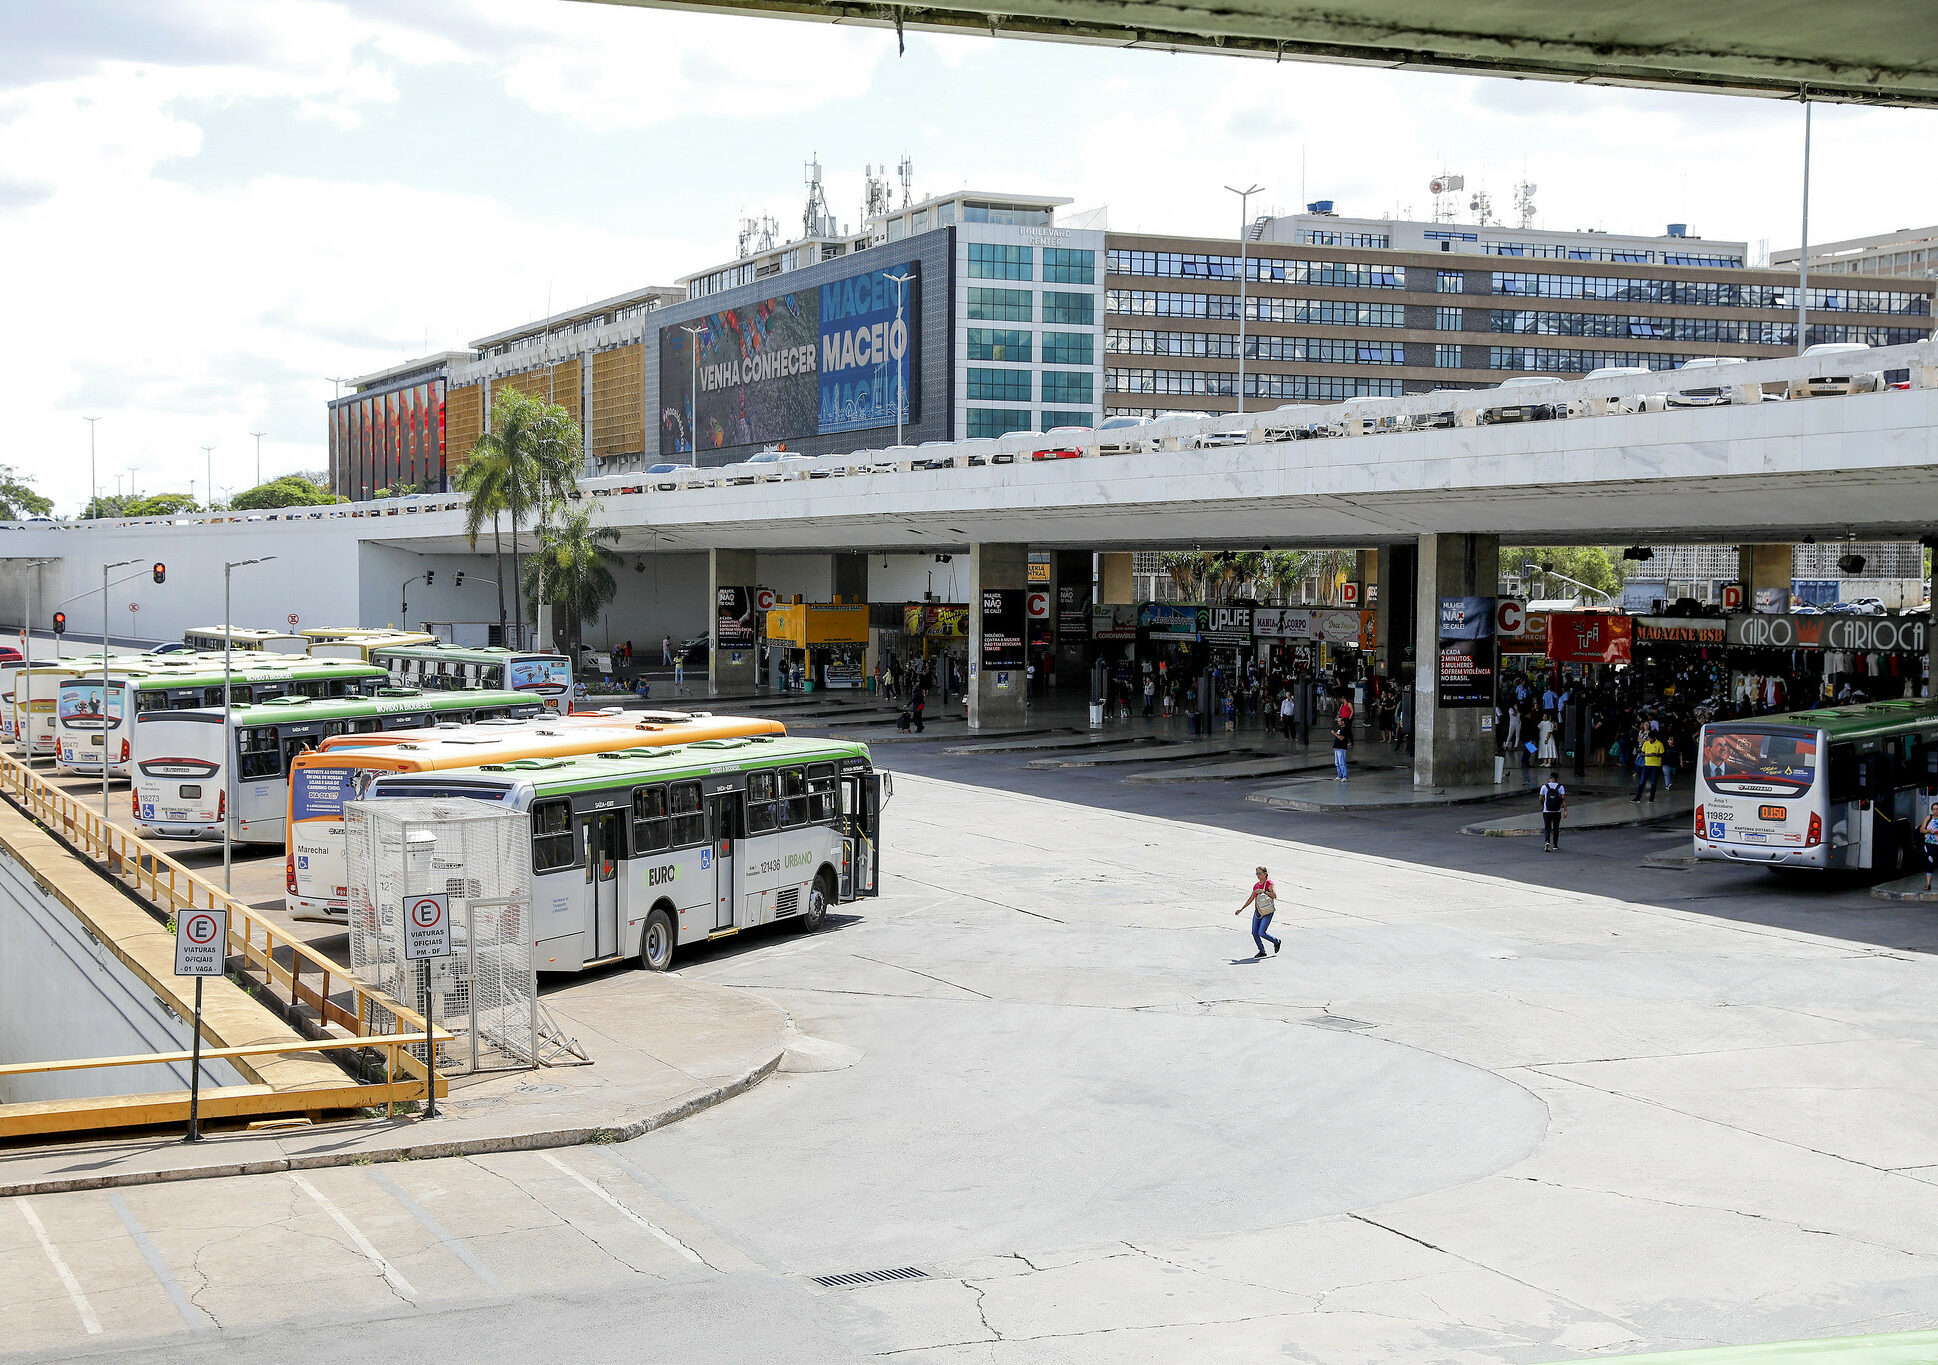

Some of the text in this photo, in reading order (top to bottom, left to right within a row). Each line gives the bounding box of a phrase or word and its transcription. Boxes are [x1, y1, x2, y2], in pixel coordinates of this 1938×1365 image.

[1019, 227, 1071, 238] BOULEVARD
[699, 344, 817, 392] VENHA CONHECER
[1344, 584, 1356, 600] D
[1725, 587, 1740, 607] D
[758, 591, 773, 609] C
[983, 597, 1002, 609] NÃO
[1027, 594, 1046, 616] C
[1208, 608, 1250, 631] UPLIFE
[1442, 608, 1465, 621] NÃO
[1498, 602, 1521, 632] C
[1256, 618, 1307, 629] MANIA CORPO
[1636, 626, 1724, 642] MAGAZINE BSB
[1828, 619, 1924, 650] CARIOCA
[1463, 667, 1491, 675] VIOLÊNCIA
[375, 702, 399, 713] MOVIDO
[404, 700, 433, 711] BIODIESEL
[1706, 811, 1734, 821] 119822
[1761, 807, 1786, 819] 0.150
[297, 845, 329, 855] Marechal
[760, 850, 813, 873] 121436 URBANO
[419, 904, 433, 922] E
[195, 920, 208, 938] E
[410, 929, 445, 938] VIATURAS
[183, 946, 216, 954] VIATURAS
[431, 947, 441, 955] DF
